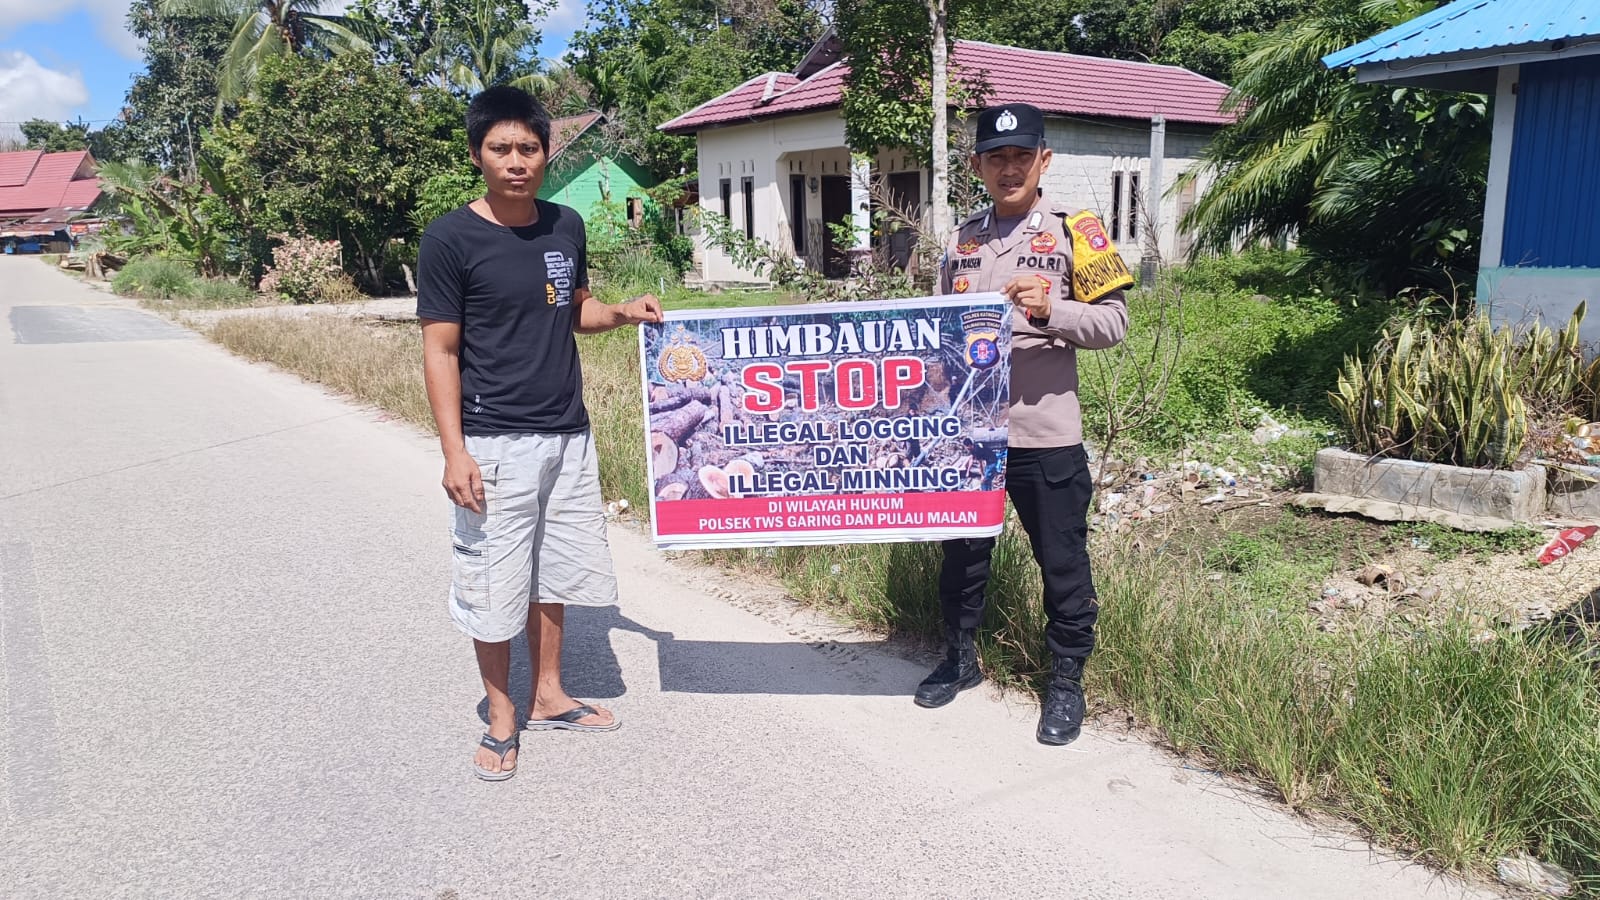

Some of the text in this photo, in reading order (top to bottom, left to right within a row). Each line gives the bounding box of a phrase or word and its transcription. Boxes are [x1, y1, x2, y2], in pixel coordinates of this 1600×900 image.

[1017, 256, 1061, 270] POLRI
[546, 283, 556, 304] CUP
[721, 318, 942, 360] HIMBAUAN
[741, 358, 926, 414] STOP
[724, 416, 961, 446] ILLEGAL LOGGING
[815, 446, 868, 467] DAN
[729, 468, 961, 495] ILLEGAL MINNING
[768, 498, 904, 514] DI WILAYAH HUKUM
[699, 511, 977, 531] POLSEK TWS GARING DAN PULAU MALAN
